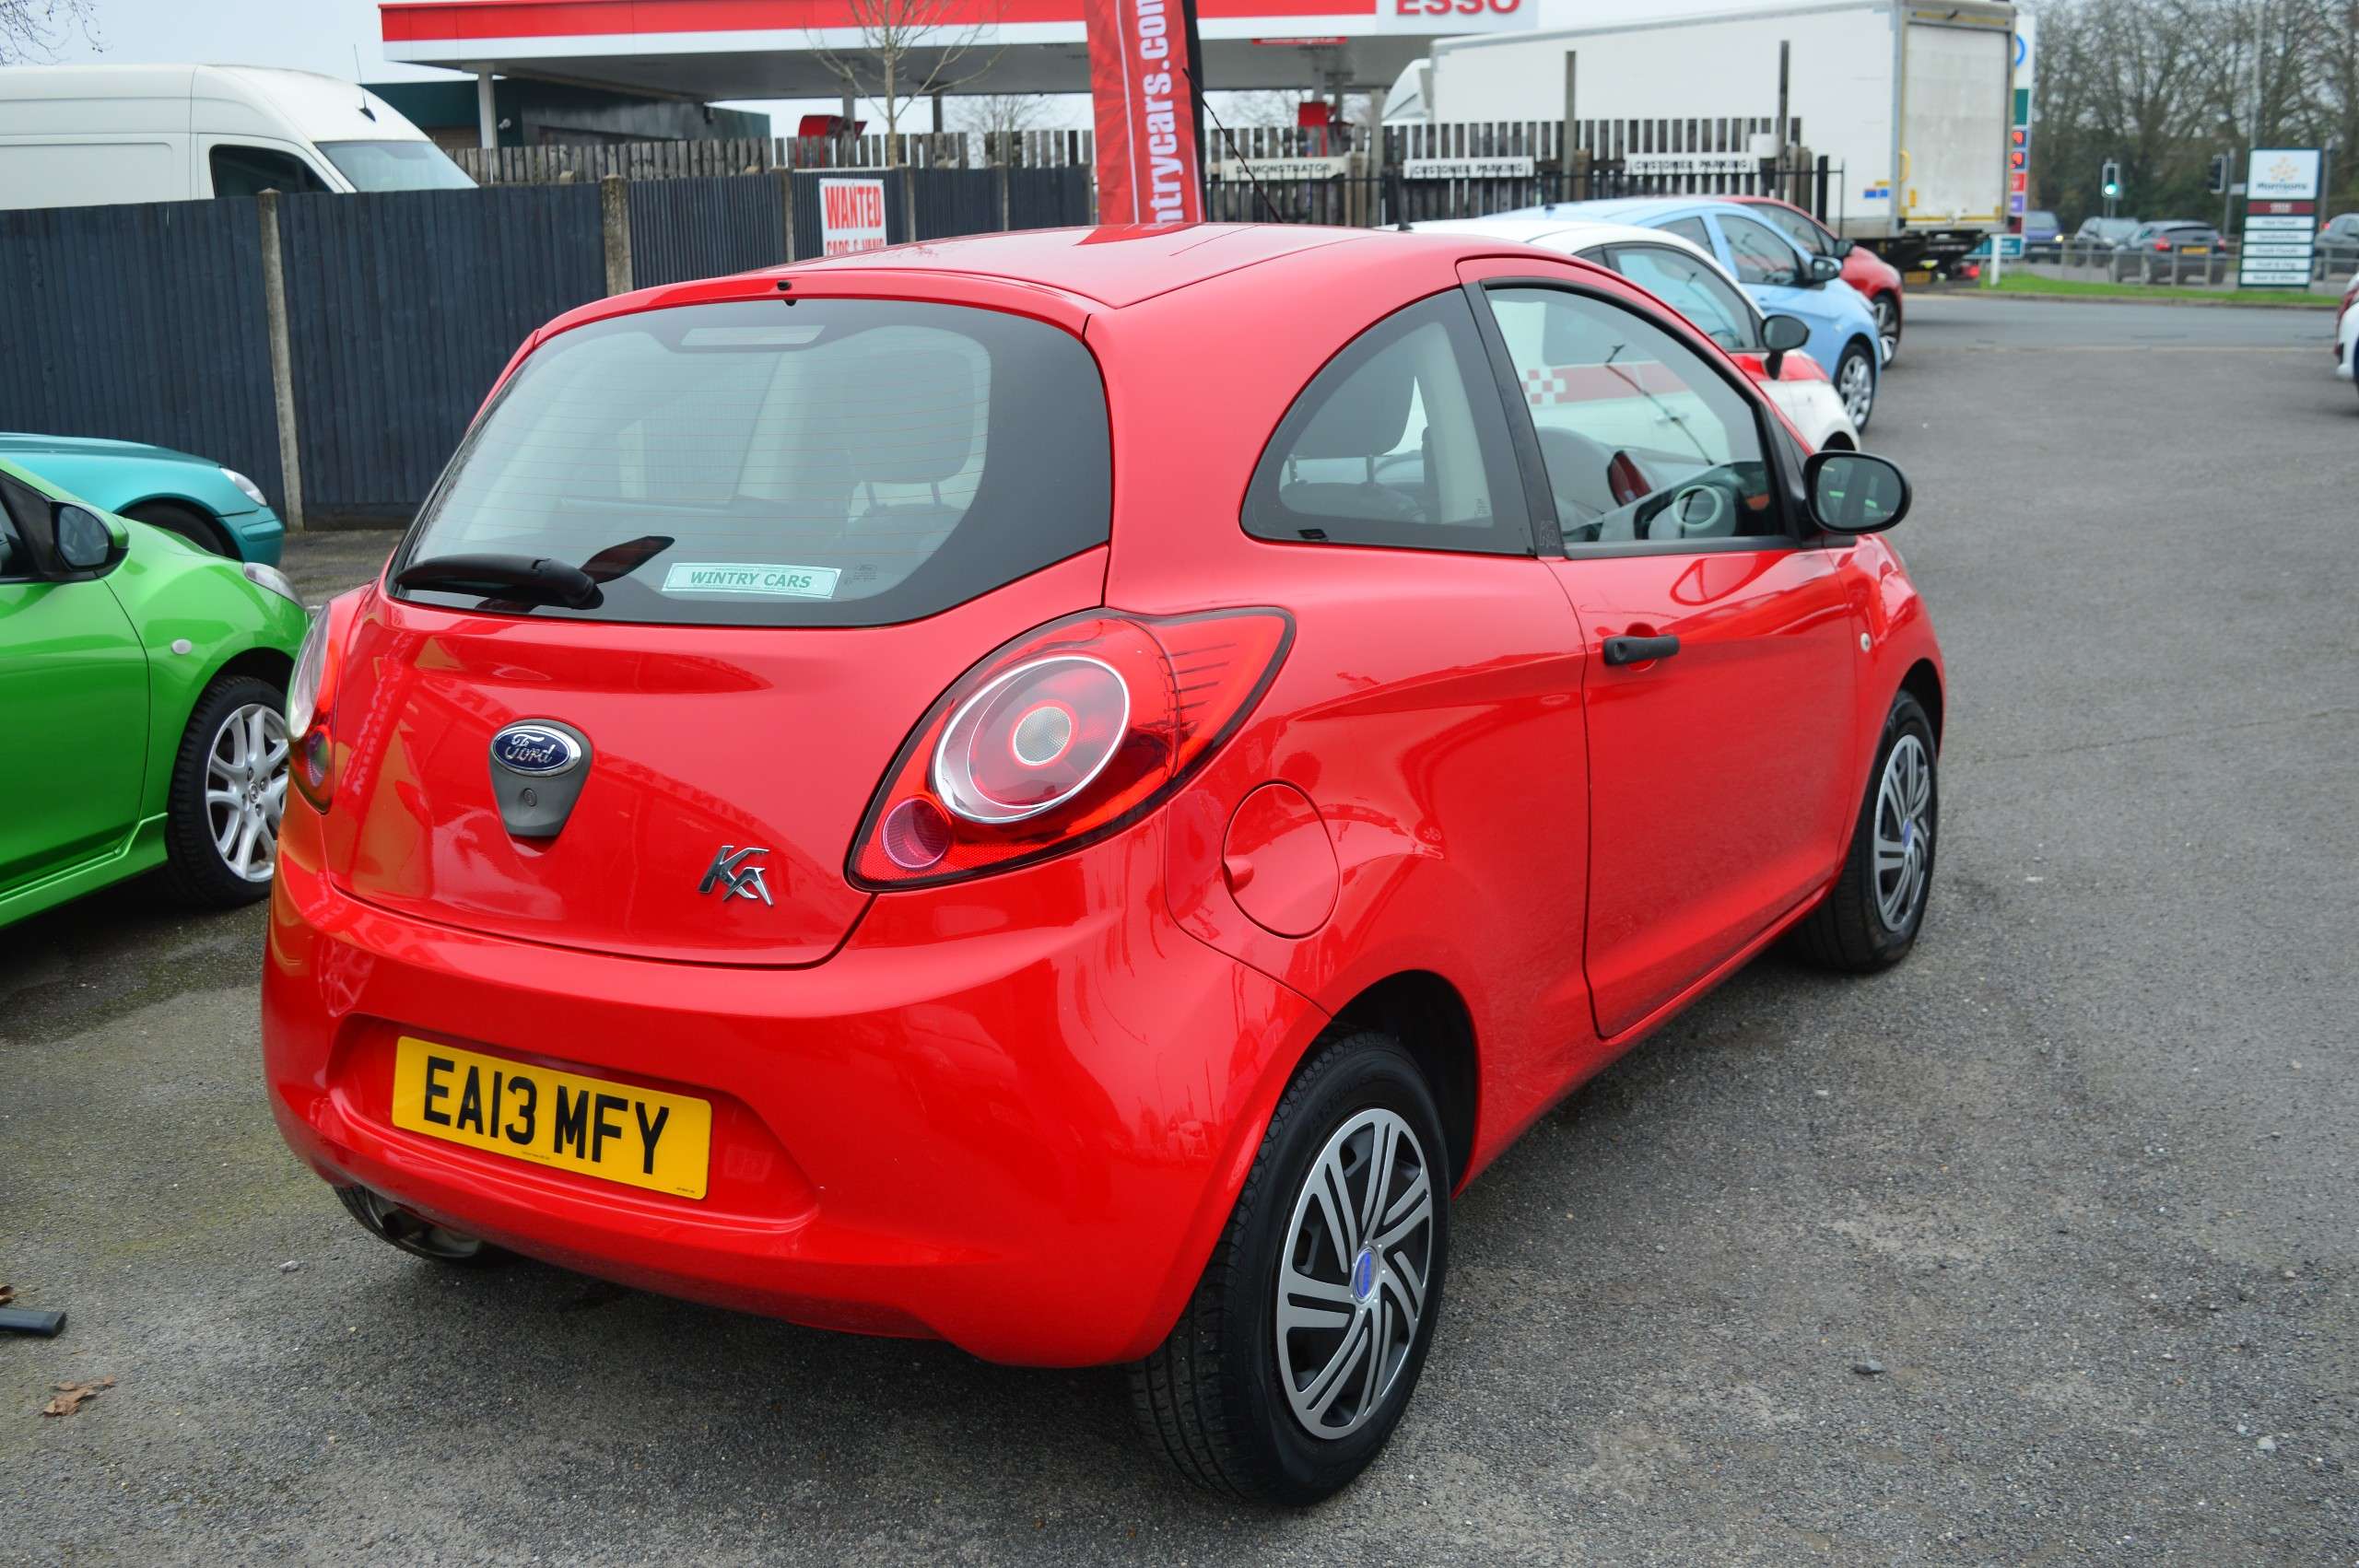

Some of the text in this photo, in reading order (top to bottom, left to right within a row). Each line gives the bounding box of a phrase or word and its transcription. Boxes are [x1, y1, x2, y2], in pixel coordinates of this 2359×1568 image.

[1236, 161, 1332, 174] DEMONSTRATOR
[1414, 162, 1523, 174] CUSTOMER PARKING
[825, 185, 883, 229] WANTED
[689, 570, 760, 587] WINTRY
[764, 574, 813, 589] CARS
[504, 733, 557, 764] Ford
[423, 1055, 670, 1175] EA13 MFY
